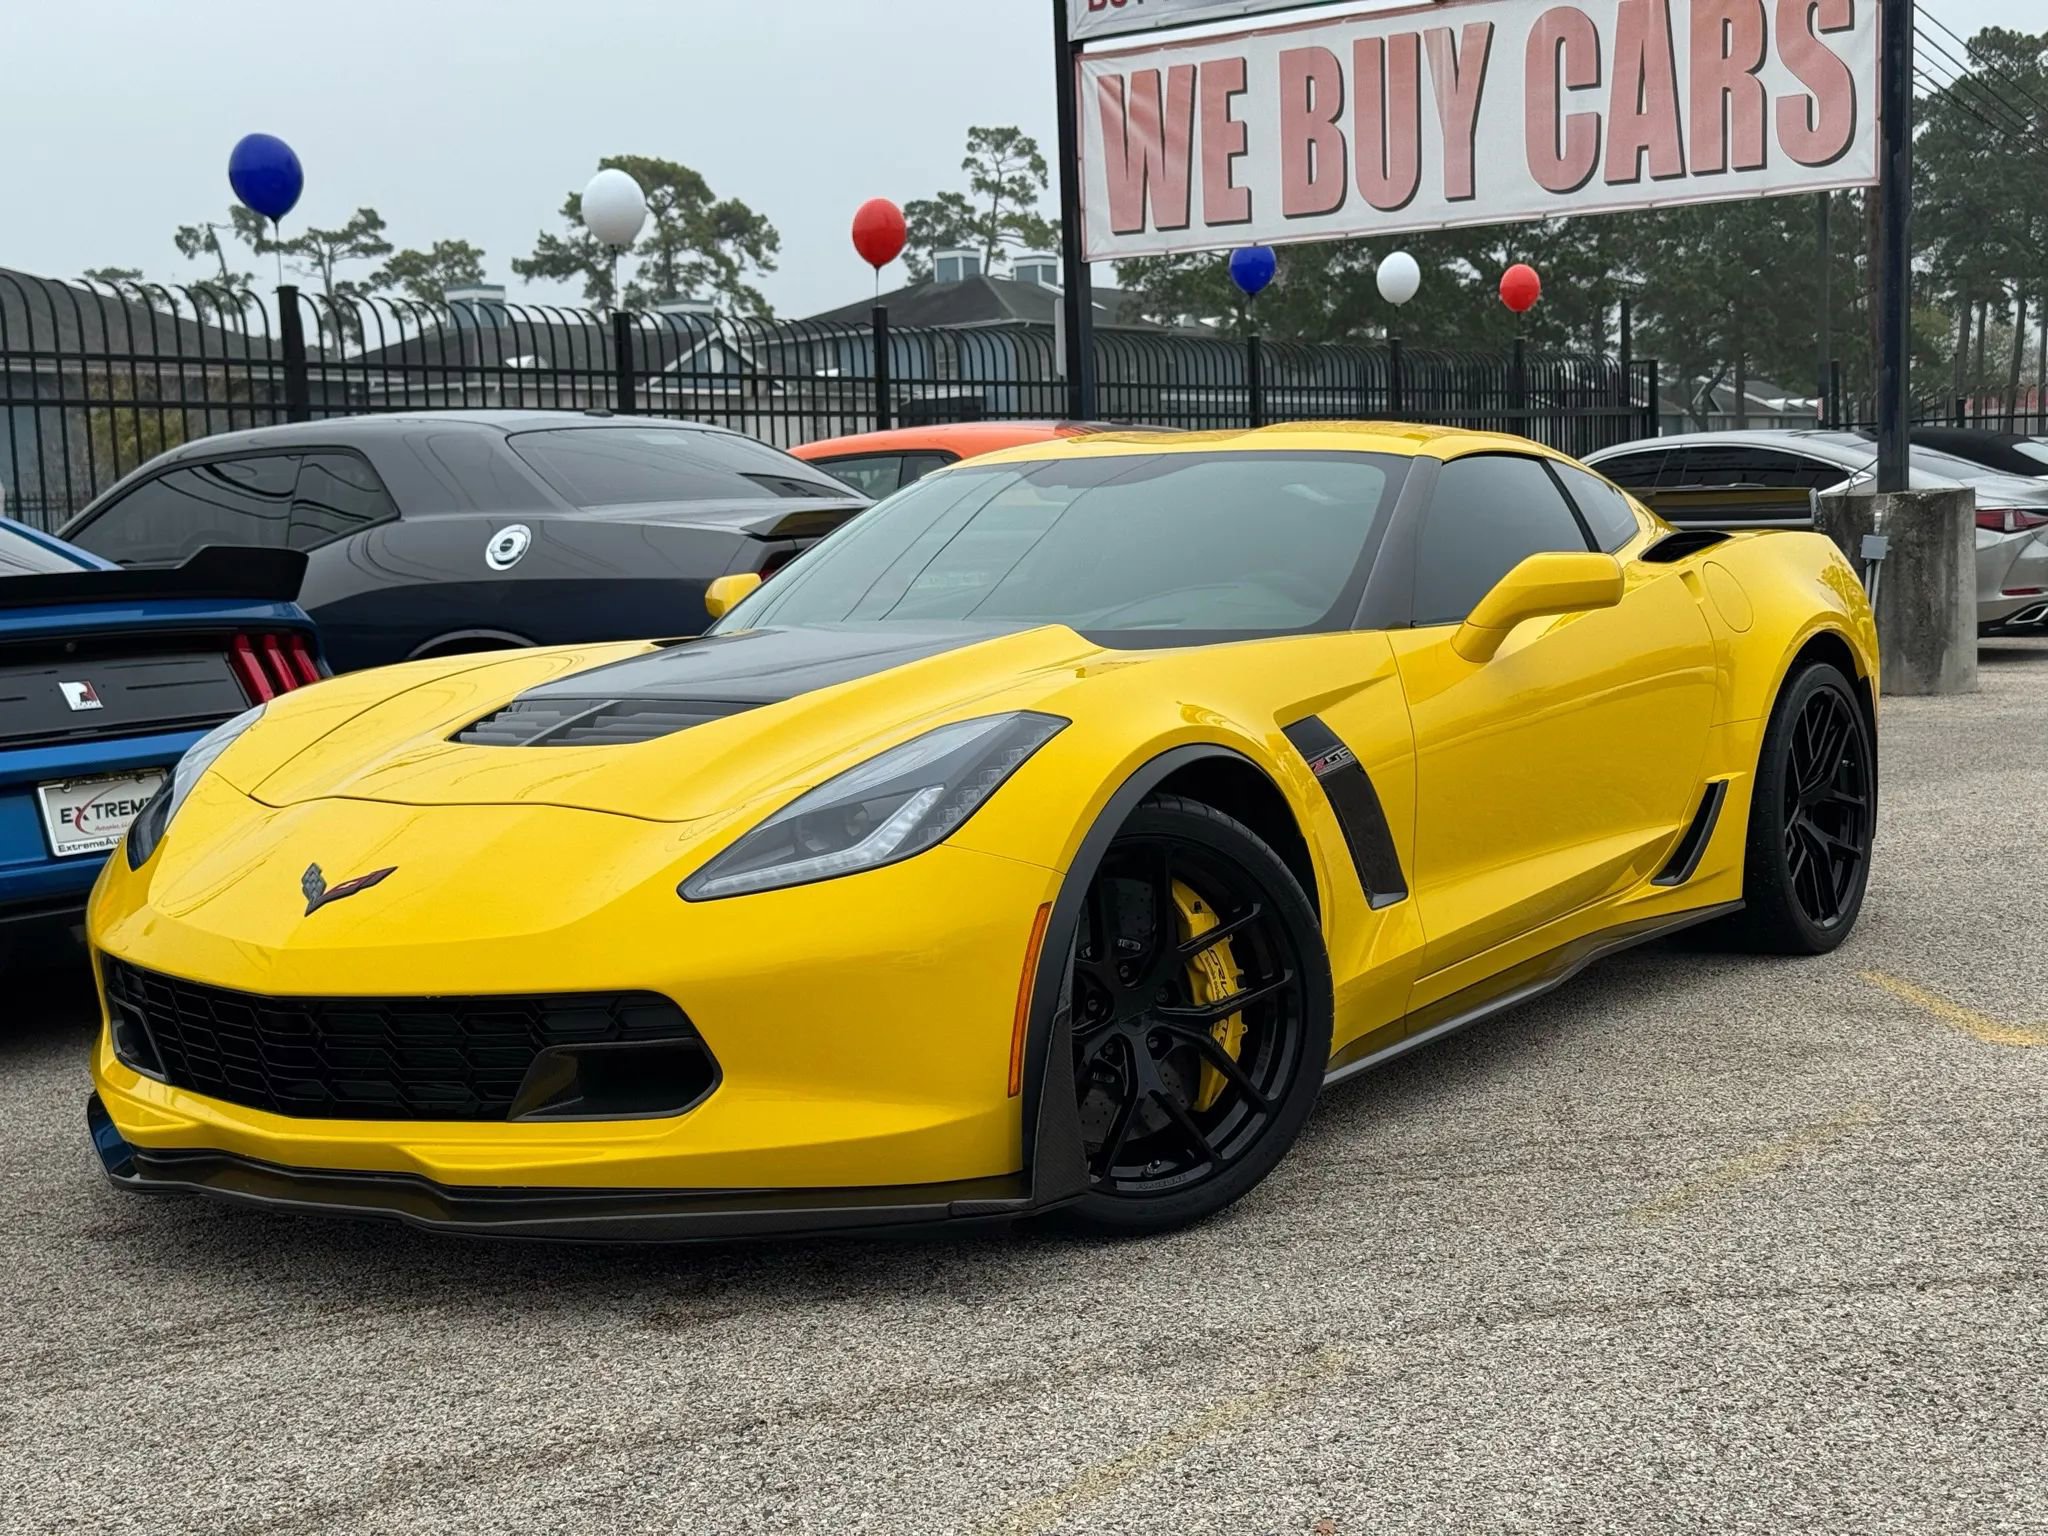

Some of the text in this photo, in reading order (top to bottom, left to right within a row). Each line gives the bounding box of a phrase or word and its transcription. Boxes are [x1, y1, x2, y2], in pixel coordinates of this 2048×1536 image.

[1097, 0, 1857, 236] WE BUY CARS
[60, 797, 151, 824] EXTREM
